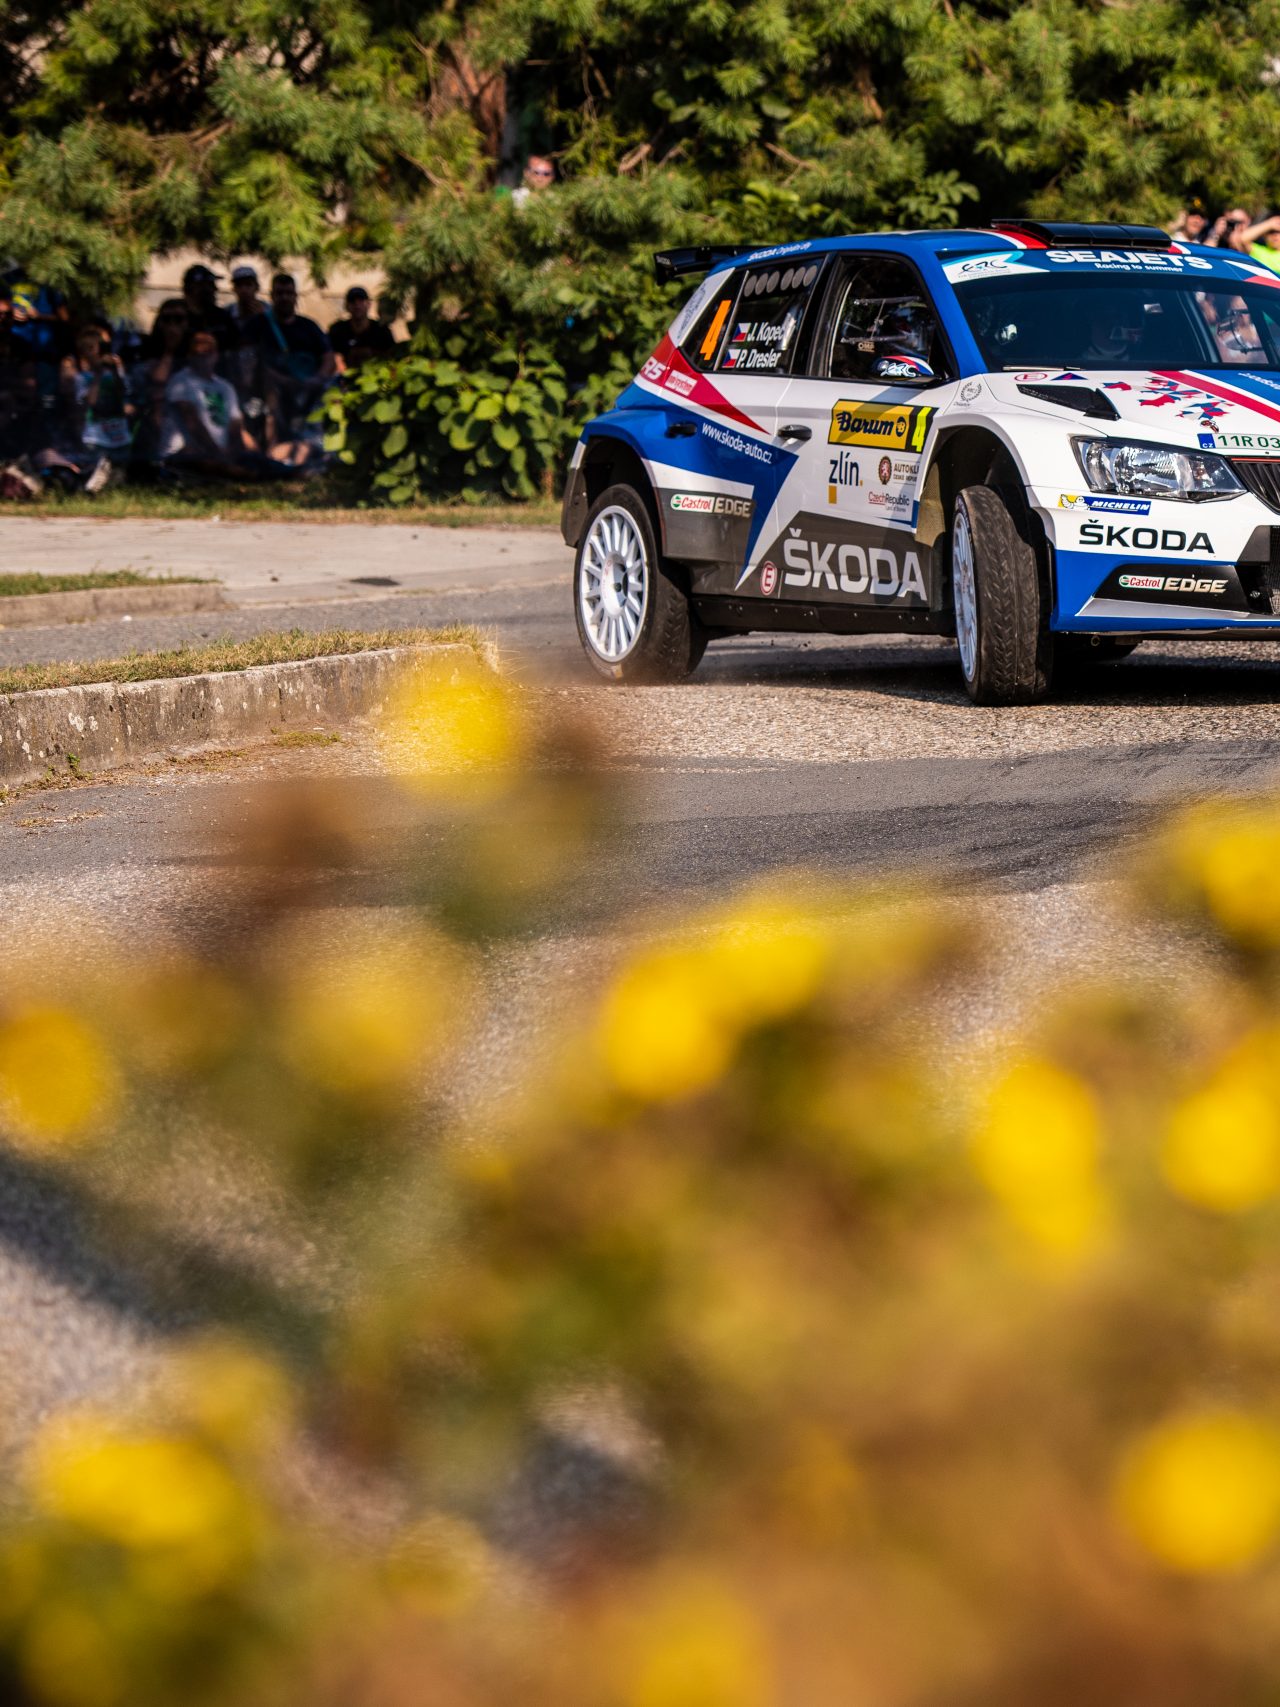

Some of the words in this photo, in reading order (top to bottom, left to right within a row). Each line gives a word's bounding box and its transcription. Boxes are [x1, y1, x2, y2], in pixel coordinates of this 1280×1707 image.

[1045, 250, 1214, 270] SEAJETS
[1094, 262, 1131, 271] Racing
[1144, 265, 1183, 273] summer
[700, 300, 732, 361] 4
[747, 322, 759, 342] J.
[640, 355, 667, 380] R5
[736, 348, 748, 369] P.
[745, 348, 782, 369] Dresler
[836, 410, 895, 436] Barum
[911, 406, 932, 452] 4
[701, 422, 772, 465] www.skoda-auto.cz
[1217, 435, 1254, 447] 11R
[681, 497, 711, 510] Castrol
[714, 496, 752, 518] EDGE
[1091, 500, 1150, 511] MICHELIN
[1079, 518, 1216, 554] ŠKODA
[783, 527, 928, 601] ŠKODA
[1129, 577, 1161, 588] Castrol
[1163, 577, 1229, 593] EDGE
